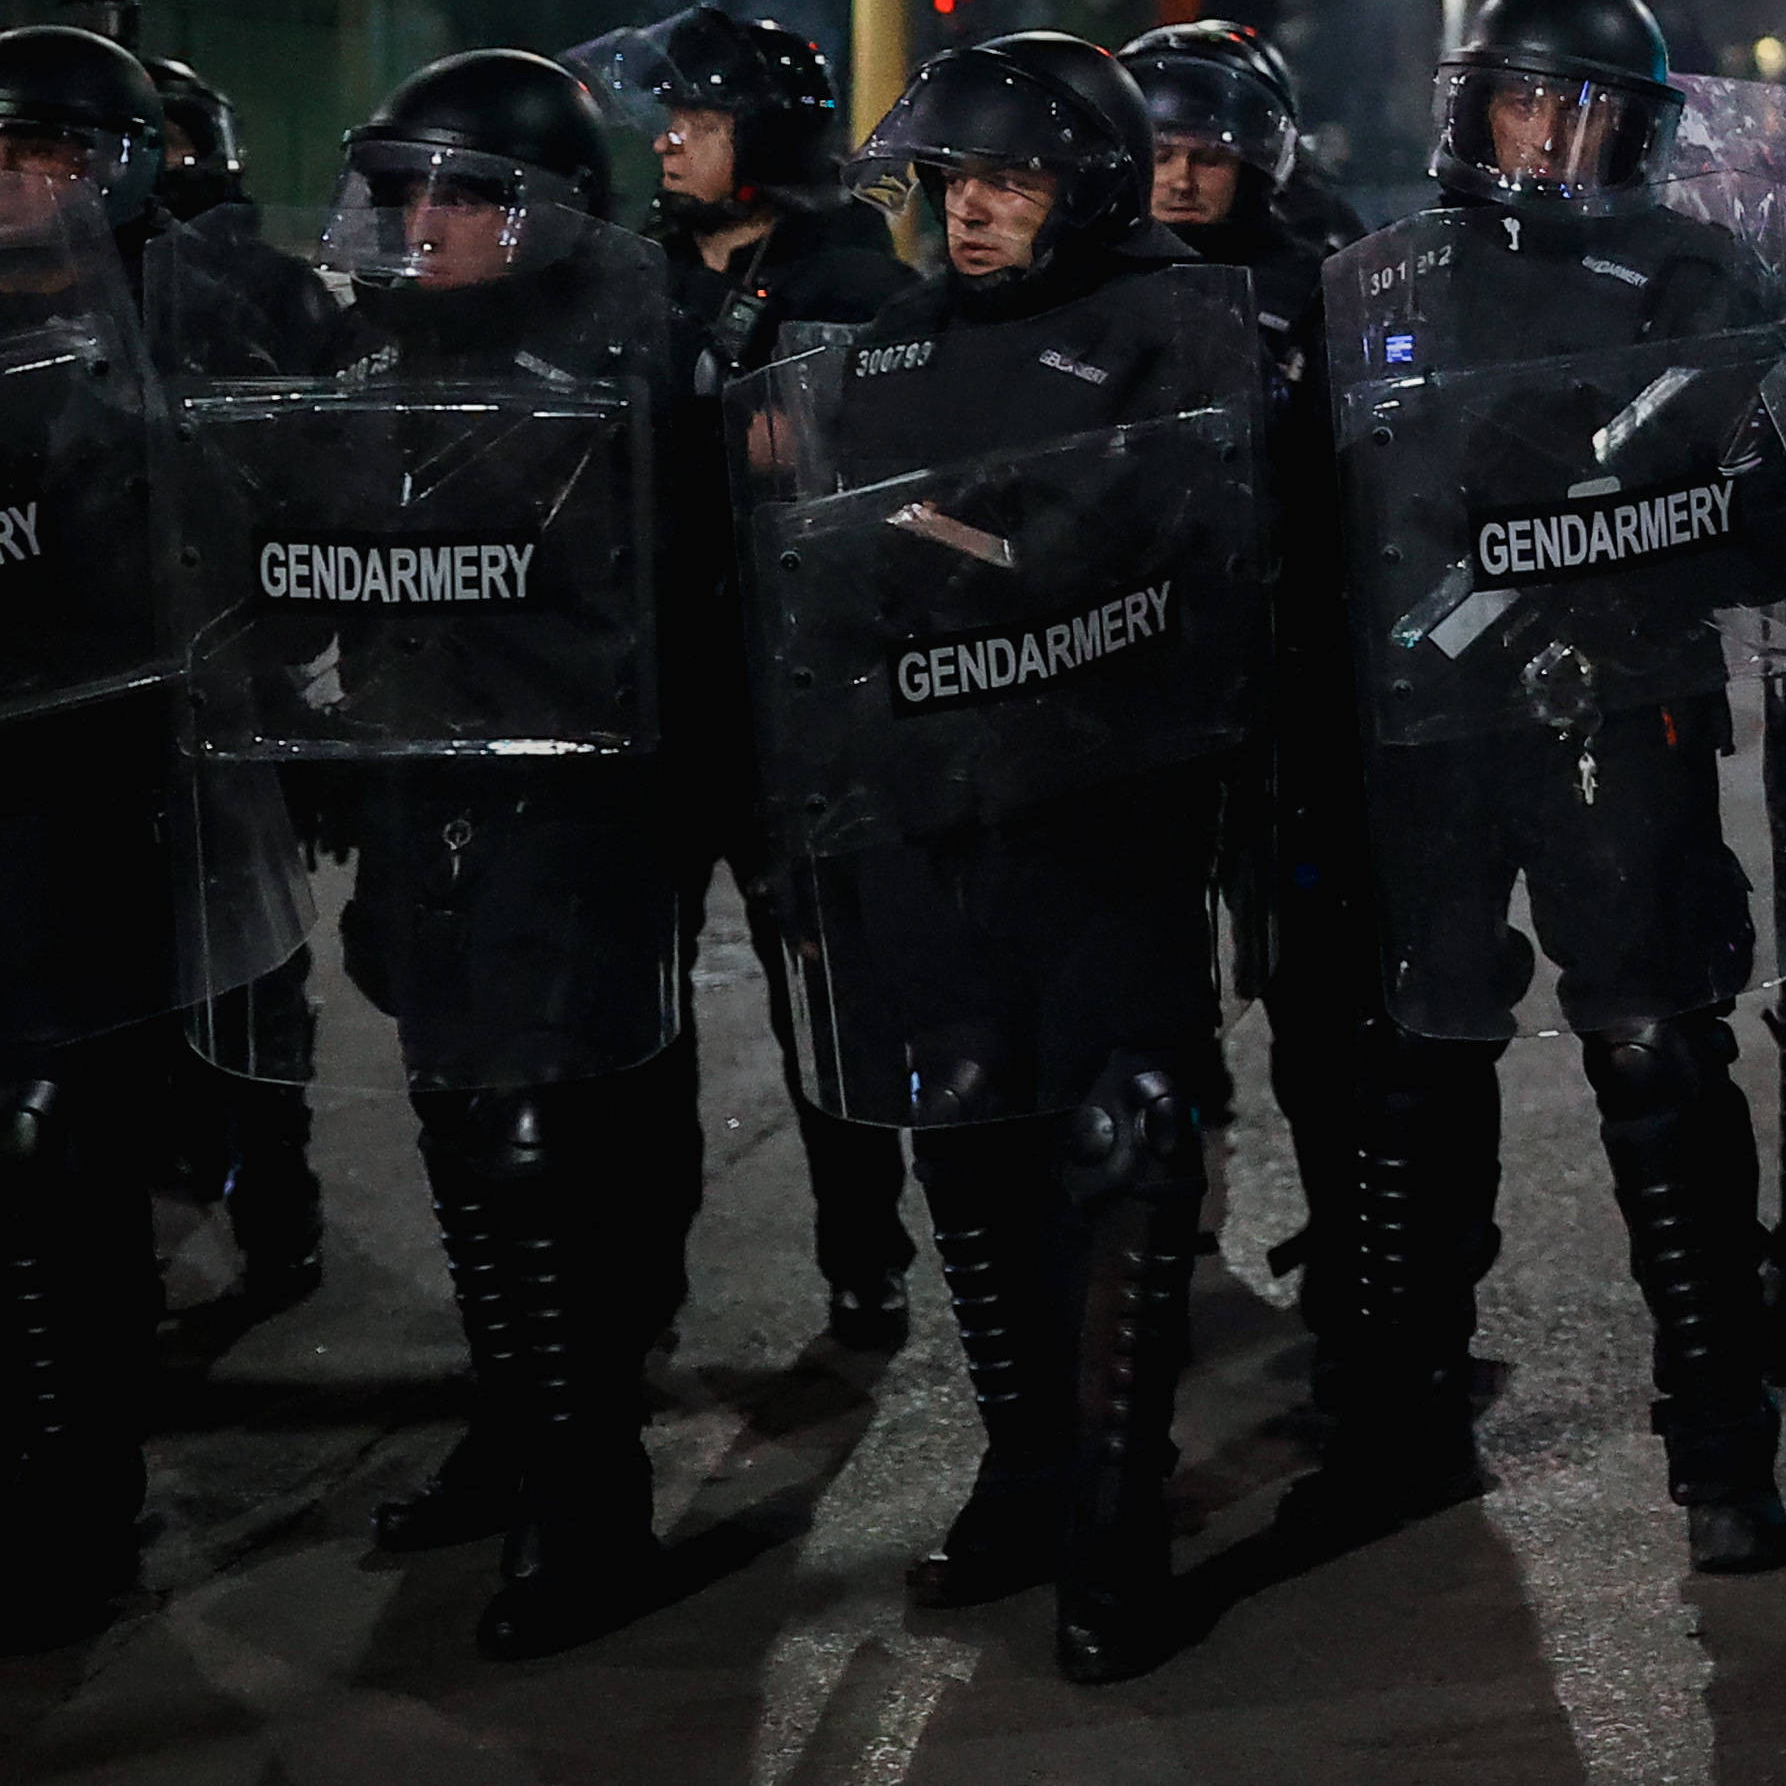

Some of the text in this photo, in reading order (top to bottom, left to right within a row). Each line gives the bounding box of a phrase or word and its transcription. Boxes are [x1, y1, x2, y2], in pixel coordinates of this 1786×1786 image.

[260, 542, 534, 603] GENDARMERY
[1480, 481, 1734, 575] GENDARMERY
[898, 580, 1171, 702] GENDARMERY
